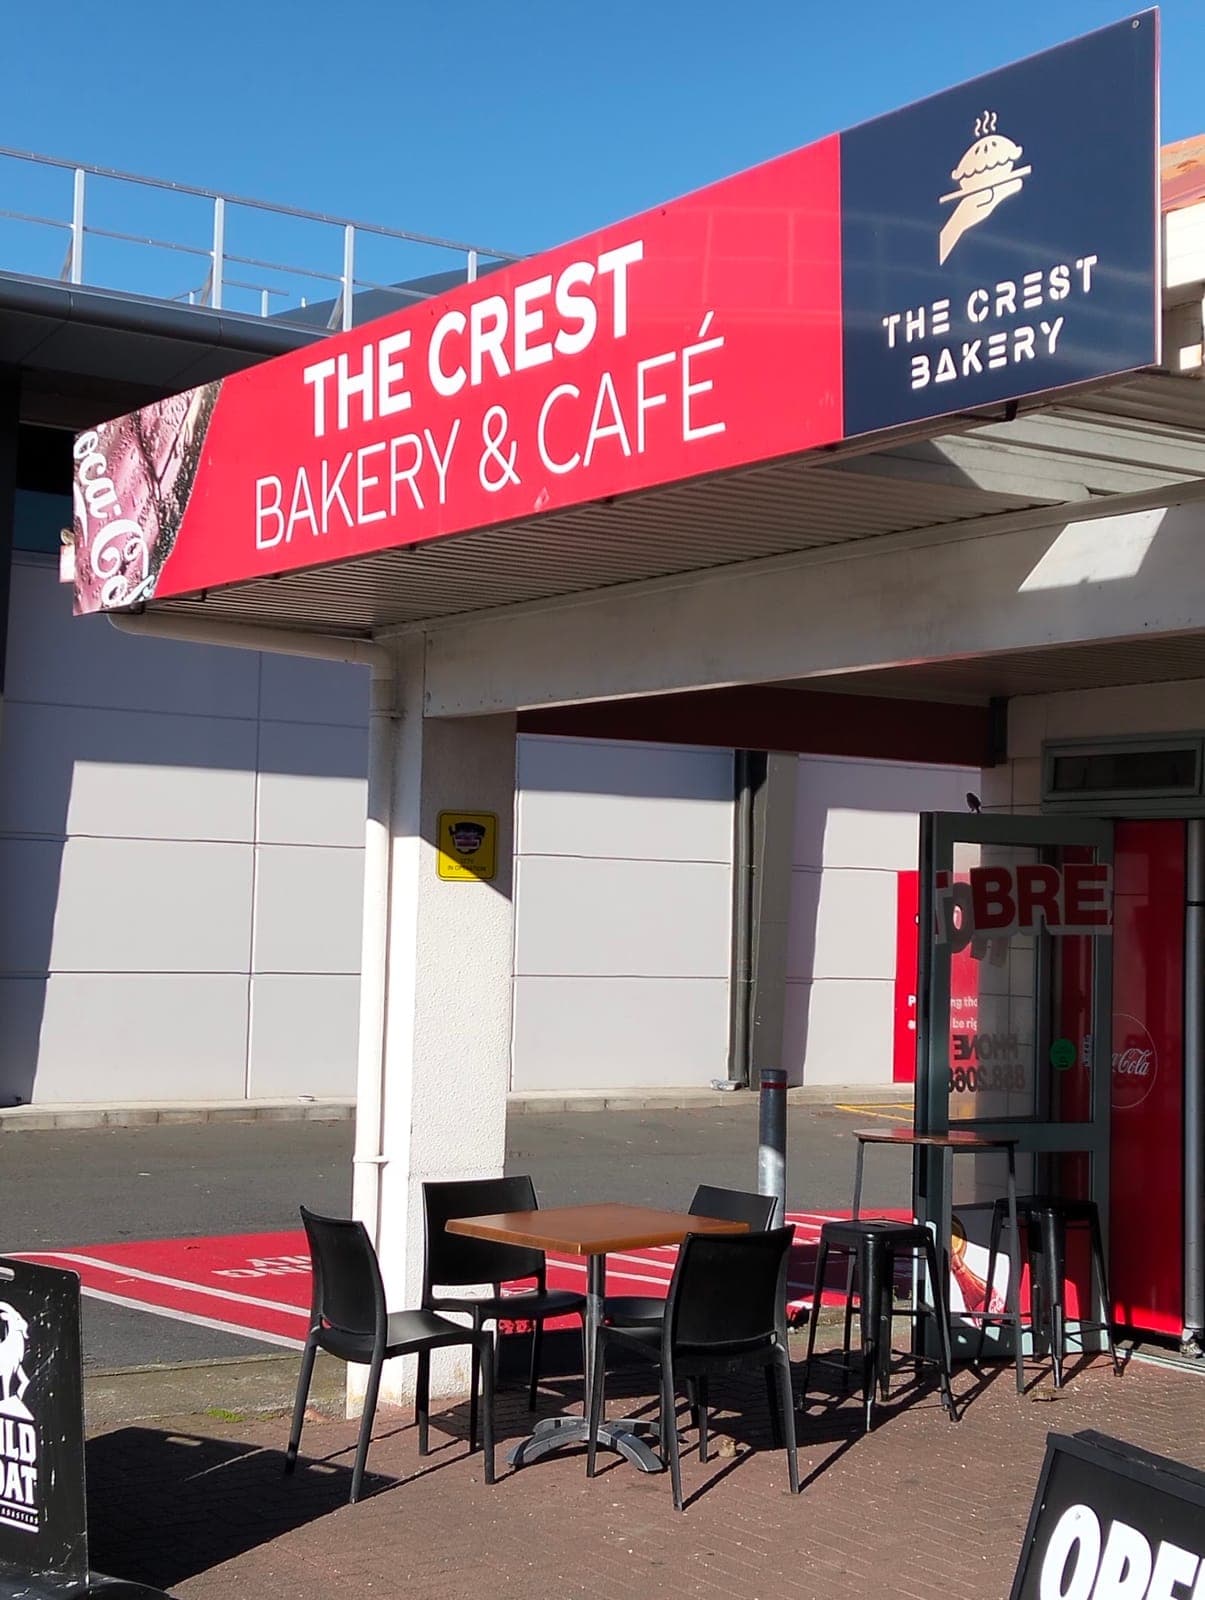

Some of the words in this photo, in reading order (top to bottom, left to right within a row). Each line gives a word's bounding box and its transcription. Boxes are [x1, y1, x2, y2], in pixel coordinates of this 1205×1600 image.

[303, 331, 412, 438] THE
[428, 240, 643, 397] CREST
[883, 300, 950, 348] THE
[967, 255, 1098, 323] CREST
[911, 317, 1064, 390] BAKERY
[256, 419, 460, 549] BAKERY
[479, 405, 521, 492] &
[538, 311, 726, 475] CAFÉ
[970, 864, 1113, 929] BRE
